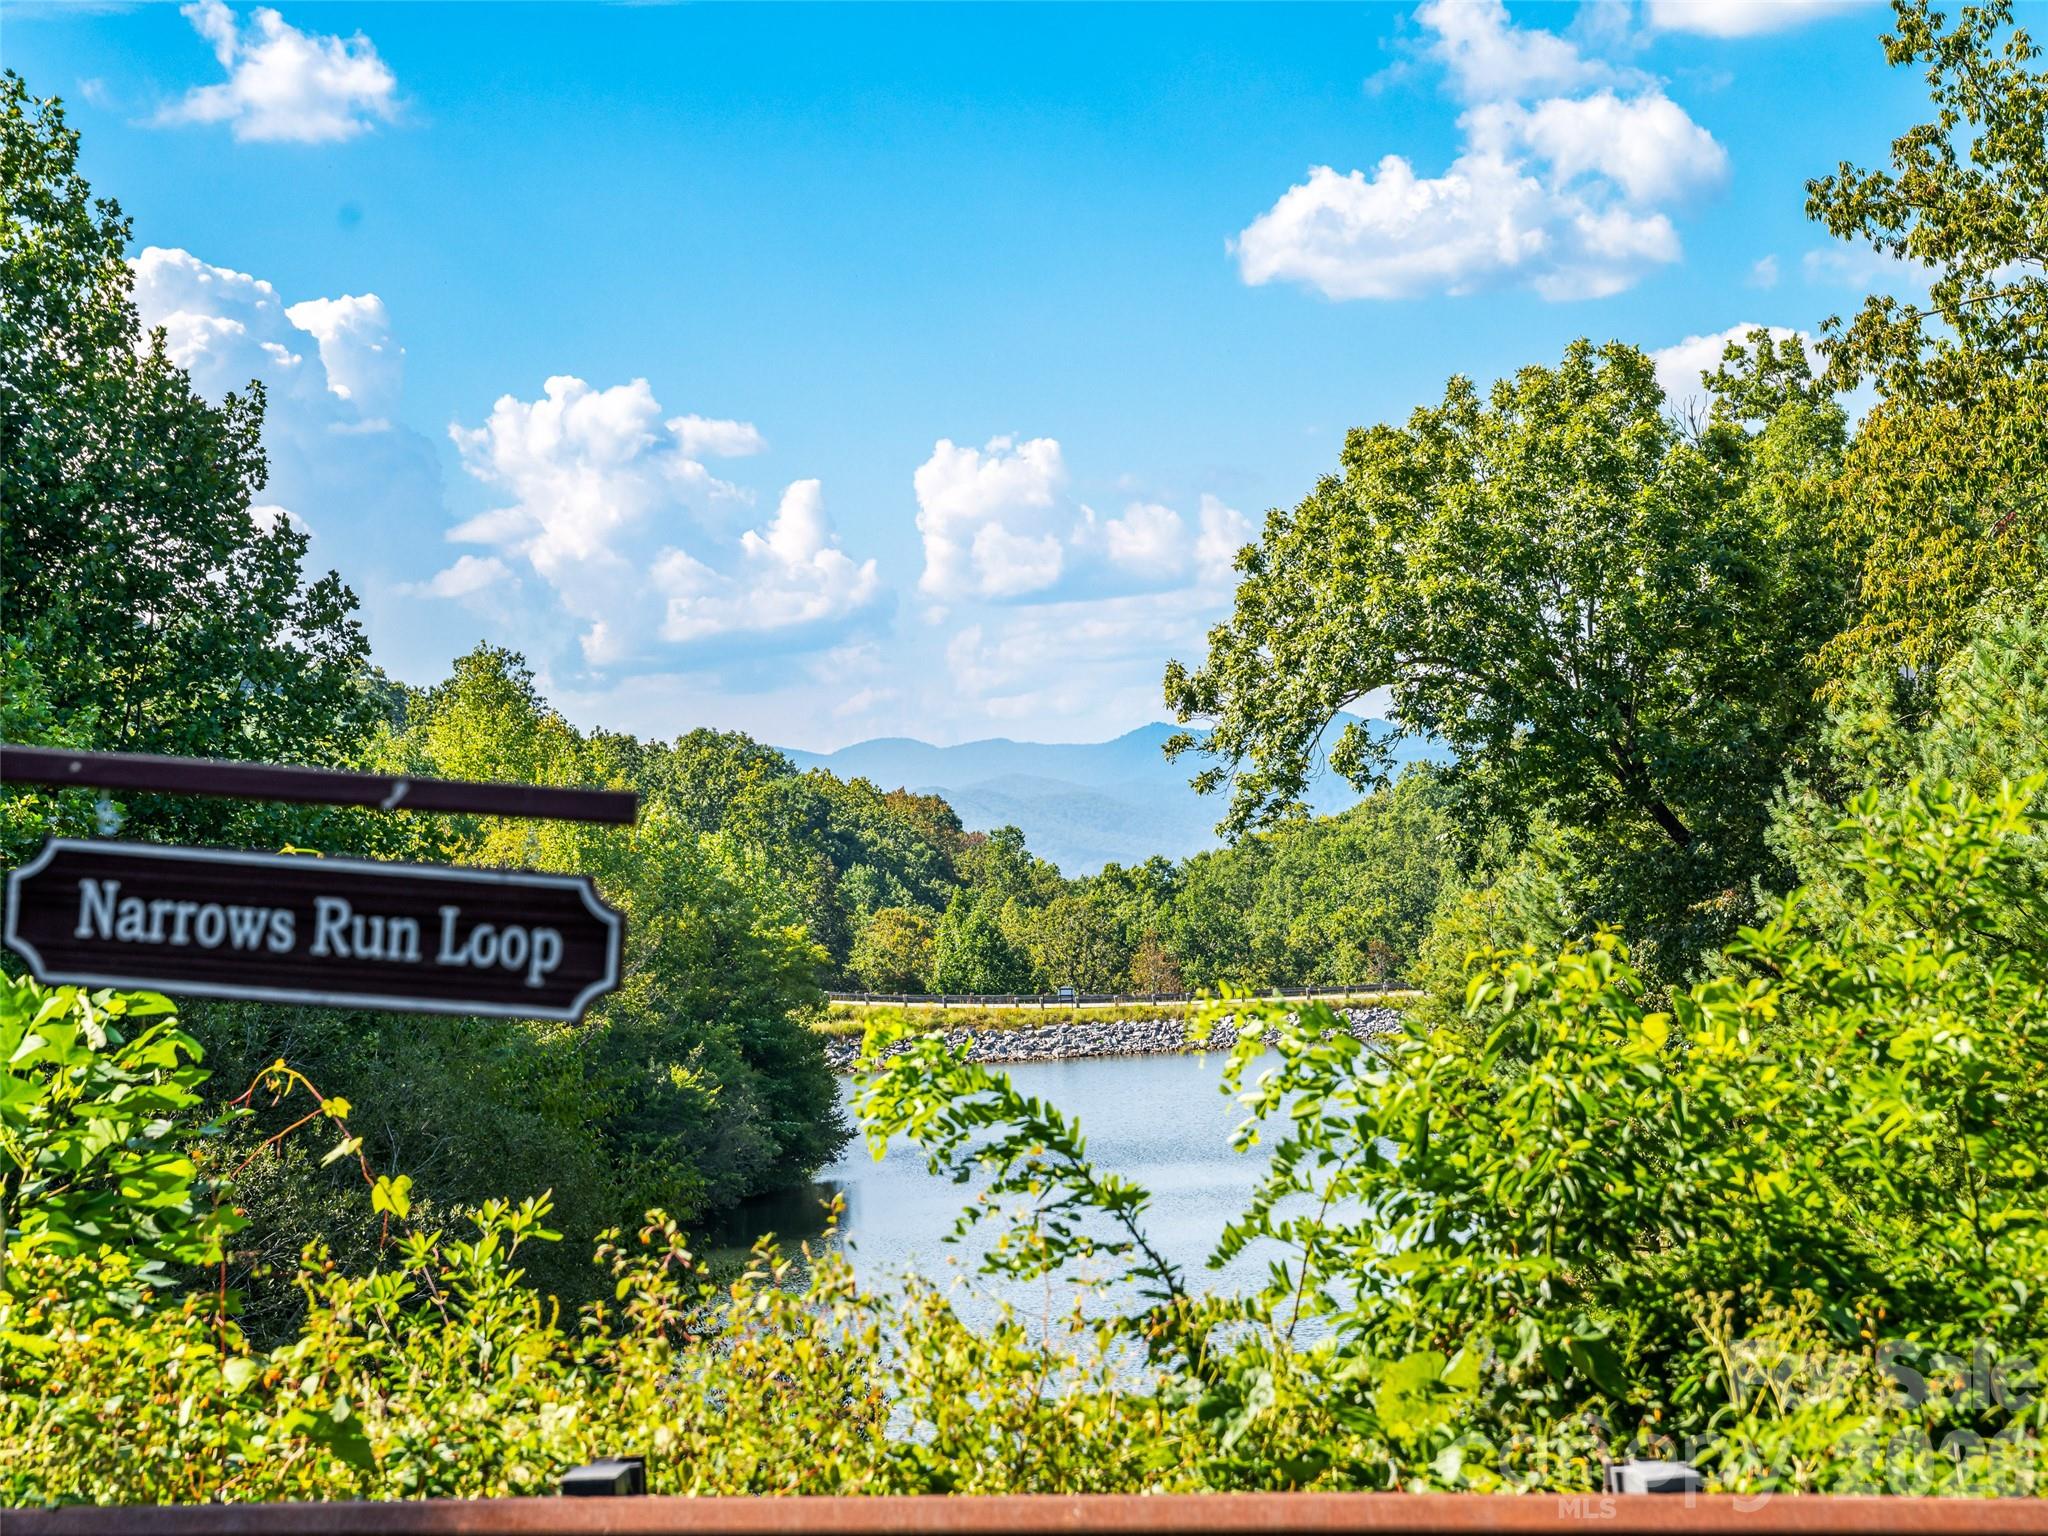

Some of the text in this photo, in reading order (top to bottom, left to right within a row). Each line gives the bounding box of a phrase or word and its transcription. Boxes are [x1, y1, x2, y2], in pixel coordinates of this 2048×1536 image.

[74, 877, 564, 988] Narrows Run Loop
